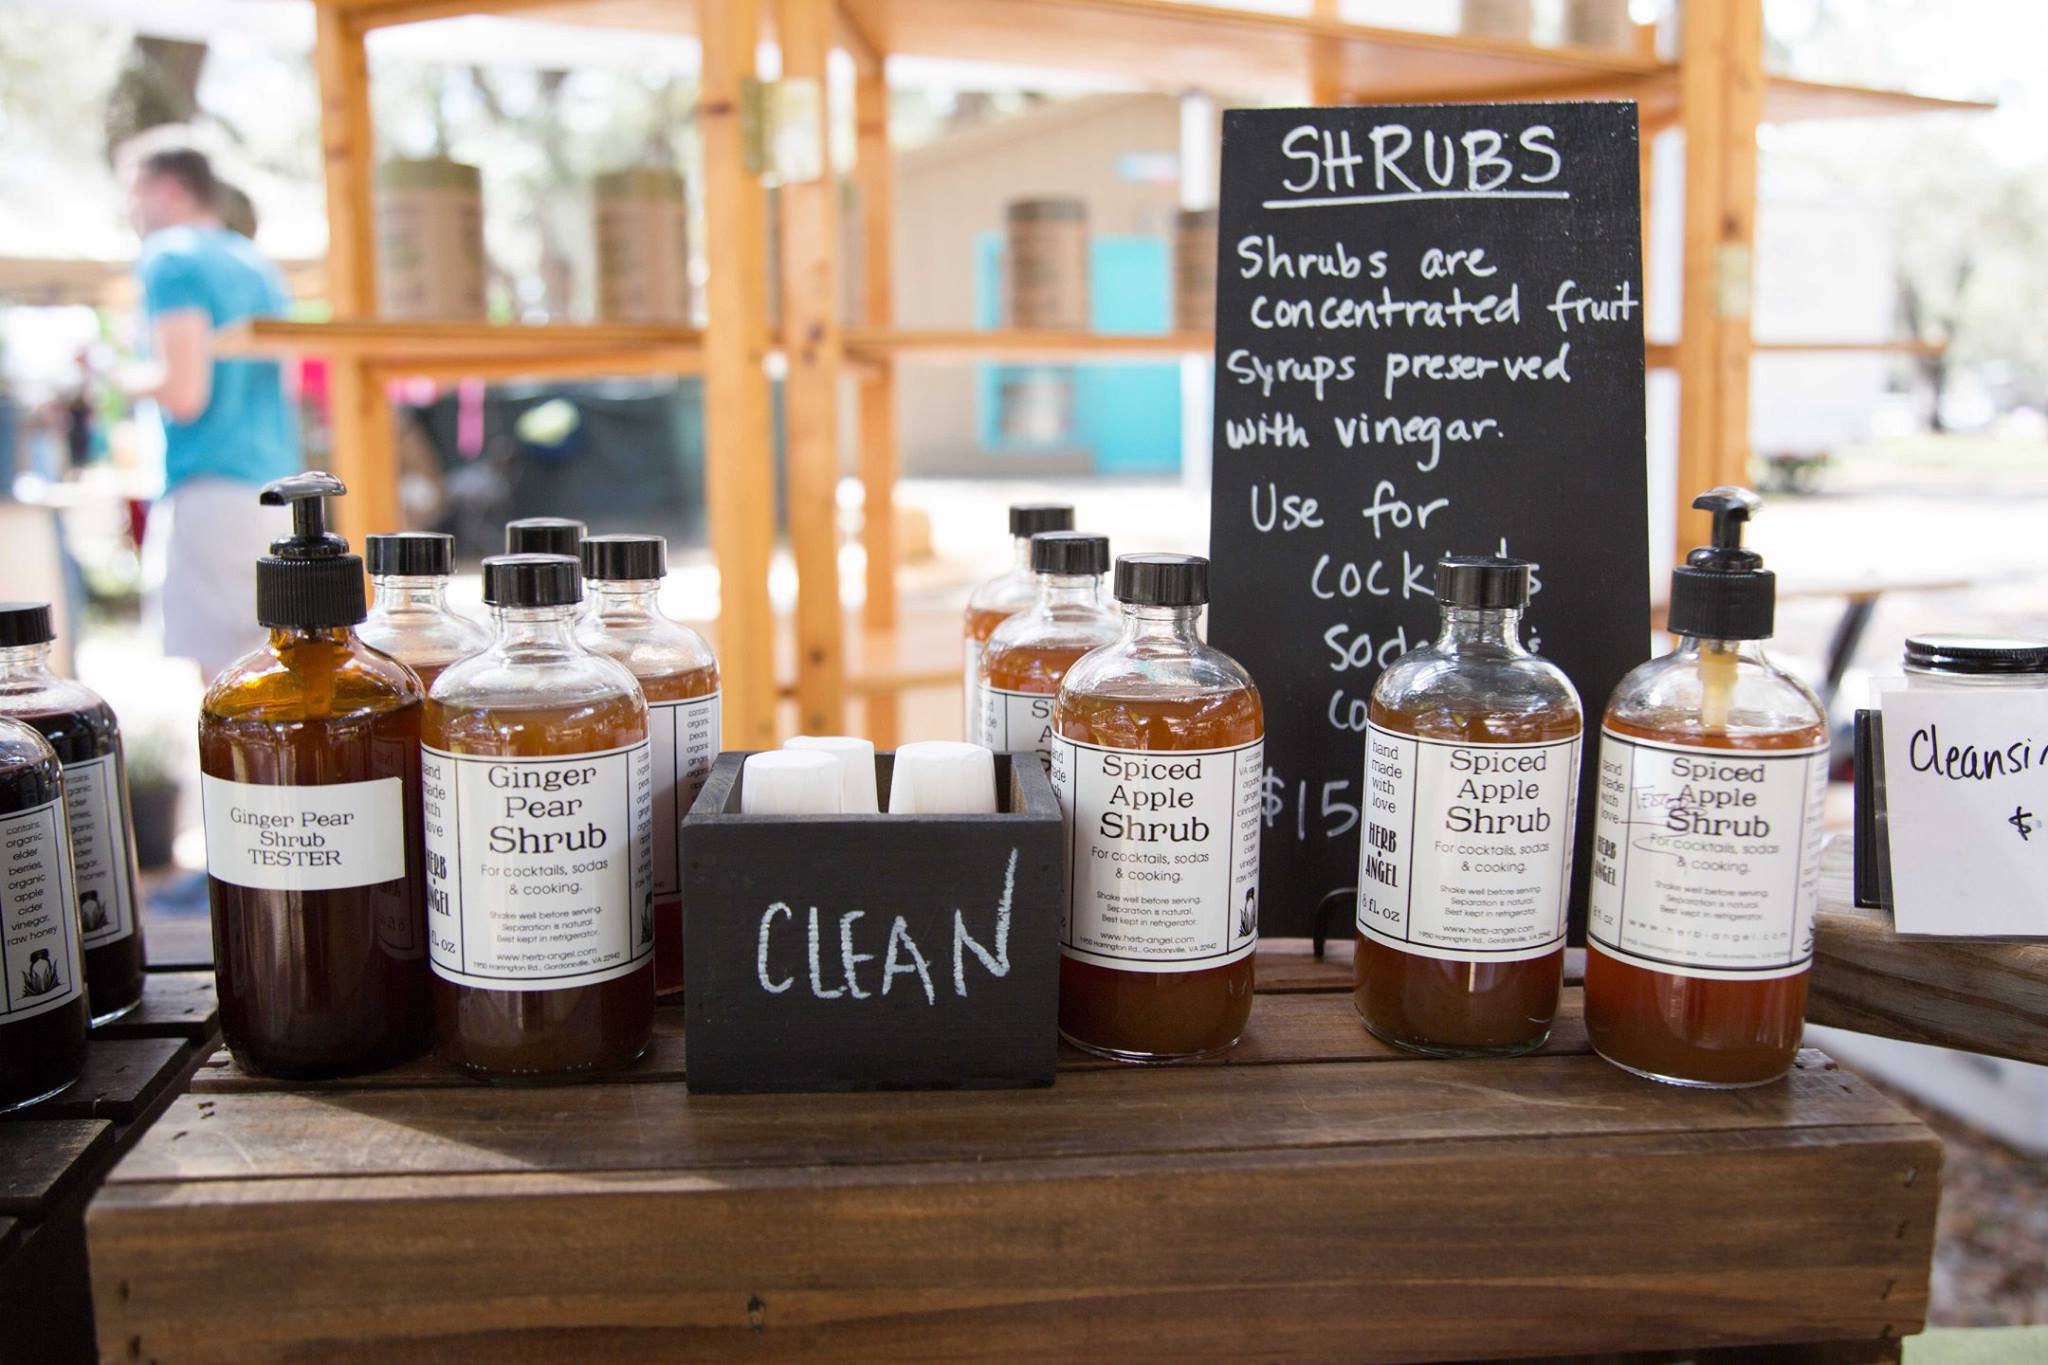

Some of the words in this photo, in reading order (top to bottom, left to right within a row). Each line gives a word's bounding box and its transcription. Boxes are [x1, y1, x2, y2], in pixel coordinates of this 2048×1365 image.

[1282, 124, 1562, 192] SHRUBS
[1237, 234, 1388, 279] Shrubs
[1420, 248, 1498, 279] are
[1250, 283, 1520, 330] concentrated
[1547, 280, 1639, 332] fruit
[1384, 342, 1572, 400] preserved
[1226, 412, 1310, 450] with
[1334, 413, 1504, 472] vinegar.
[1250, 483, 1324, 532] Use
[1362, 480, 1449, 539] for
[1373, 739, 1399, 760] hand
[1102, 754, 1201, 782] Spiced
[1372, 759, 1402, 779] made
[1450, 749, 1547, 775] Spiced
[1672, 757, 1765, 783] Spiced
[488, 765, 597, 792] Ginger
[1372, 777, 1395, 795] with
[1109, 784, 1194, 812] Apple
[1457, 779, 1539, 804] Apple
[1679, 784, 1757, 809] Apple
[506, 796, 583, 818] Pear
[1373, 792, 1396, 813] love
[230, 807, 294, 829] Ginger
[301, 812, 354, 827] Pear
[1100, 811, 1210, 843] Shrub
[1445, 806, 1551, 834] Shrub
[1667, 808, 1770, 838] Shrub
[6, 833, 43, 848] organic
[260, 830, 325, 848] Shrub
[489, 823, 607, 854] Shrub
[1369, 821, 1397, 853] HERB
[248, 848, 342, 867] TESTER
[1091, 846, 1110, 860] For
[1111, 850, 1171, 865] cocktails,
[1174, 852, 1209, 865] sodas
[1434, 841, 1454, 852] For
[1457, 844, 1516, 855] cocktails,
[1520, 842, 1550, 855] sodas
[481, 864, 500, 876] For
[503, 865, 568, 877] cocktails,
[572, 859, 608, 874] sodas
[1115, 867, 1123, 879] &
[1128, 870, 1184, 884] cooking.
[1366, 854, 1398, 888] ANGEL
[1461, 861, 1469, 871] &
[1475, 863, 1527, 874] cooking.
[8, 873, 46, 890] organic
[509, 884, 518, 895] &
[523, 882, 583, 896] cooking.
[1440, 885, 1466, 895] Shake
[1468, 887, 1485, 895] well
[1487, 887, 1514, 896] before
[14, 888, 44, 903] apple
[1096, 890, 1121, 902] Shake
[1122, 896, 1139, 904] well
[1141, 896, 1169, 905] before
[17, 902, 43, 916] cider
[489, 911, 517, 920] Shake
[518, 911, 537, 920] well
[539, 909, 569, 920] before
[1106, 904, 1152, 916] Separation
[1369, 898, 1379, 915] fl.
[1383, 907, 1400, 922] oz
[1465, 909, 1484, 918] kept
[502, 922, 550, 932] Separation
[758, 847, 1018, 1006] CLEAN
[1101, 915, 1118, 924] Best
[1120, 917, 1138, 927] kept
[1140, 918, 1148, 926] in
[1443, 925, 1534, 935] www.herb-angel.com
[29, 925, 58, 941] honey
[516, 933, 538, 945] kept
[1100, 931, 1195, 946] www.herb-angel.com
[496, 947, 598, 961] www.herb-angel.com
